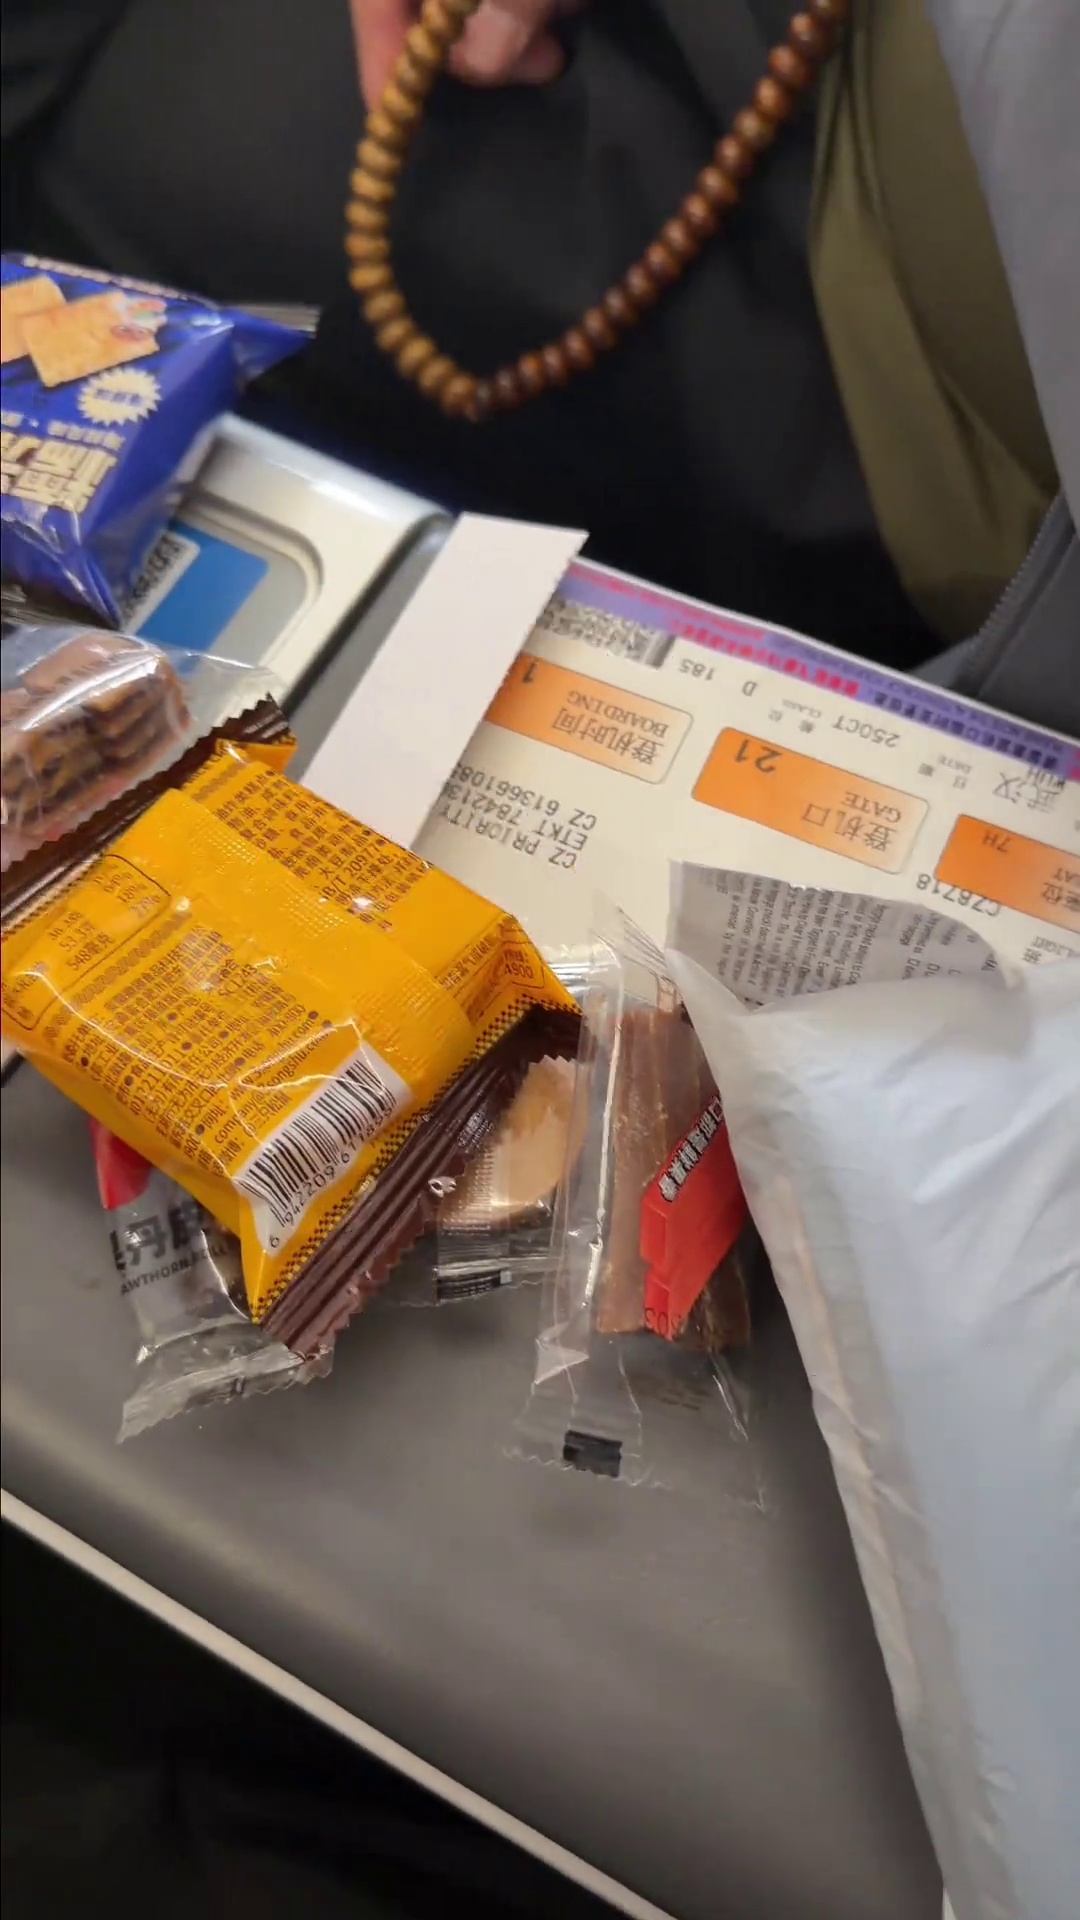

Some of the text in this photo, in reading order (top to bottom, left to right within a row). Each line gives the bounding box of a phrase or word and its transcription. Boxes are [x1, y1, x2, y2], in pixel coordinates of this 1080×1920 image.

[678, 658, 758, 697] 185 D
[567, 690, 669, 739] BOARDING
[552, 707, 666, 766] 登机时间
[734, 739, 784, 773] 21
[844, 791, 902, 823] GATE
[992, 771, 1061, 812] 武汉
[435, 802, 578, 869] CZ PRIORITY
[532, 815, 588, 851] ETKT
[568, 807, 597, 831] CZ
[801, 803, 897, 852] 登机口
[343, 842, 381, 877] 20977
[981, 830, 1014, 853] 7H
[267, 1233, 282, 1248] 6
[281, 1158, 336, 1225] 942209
